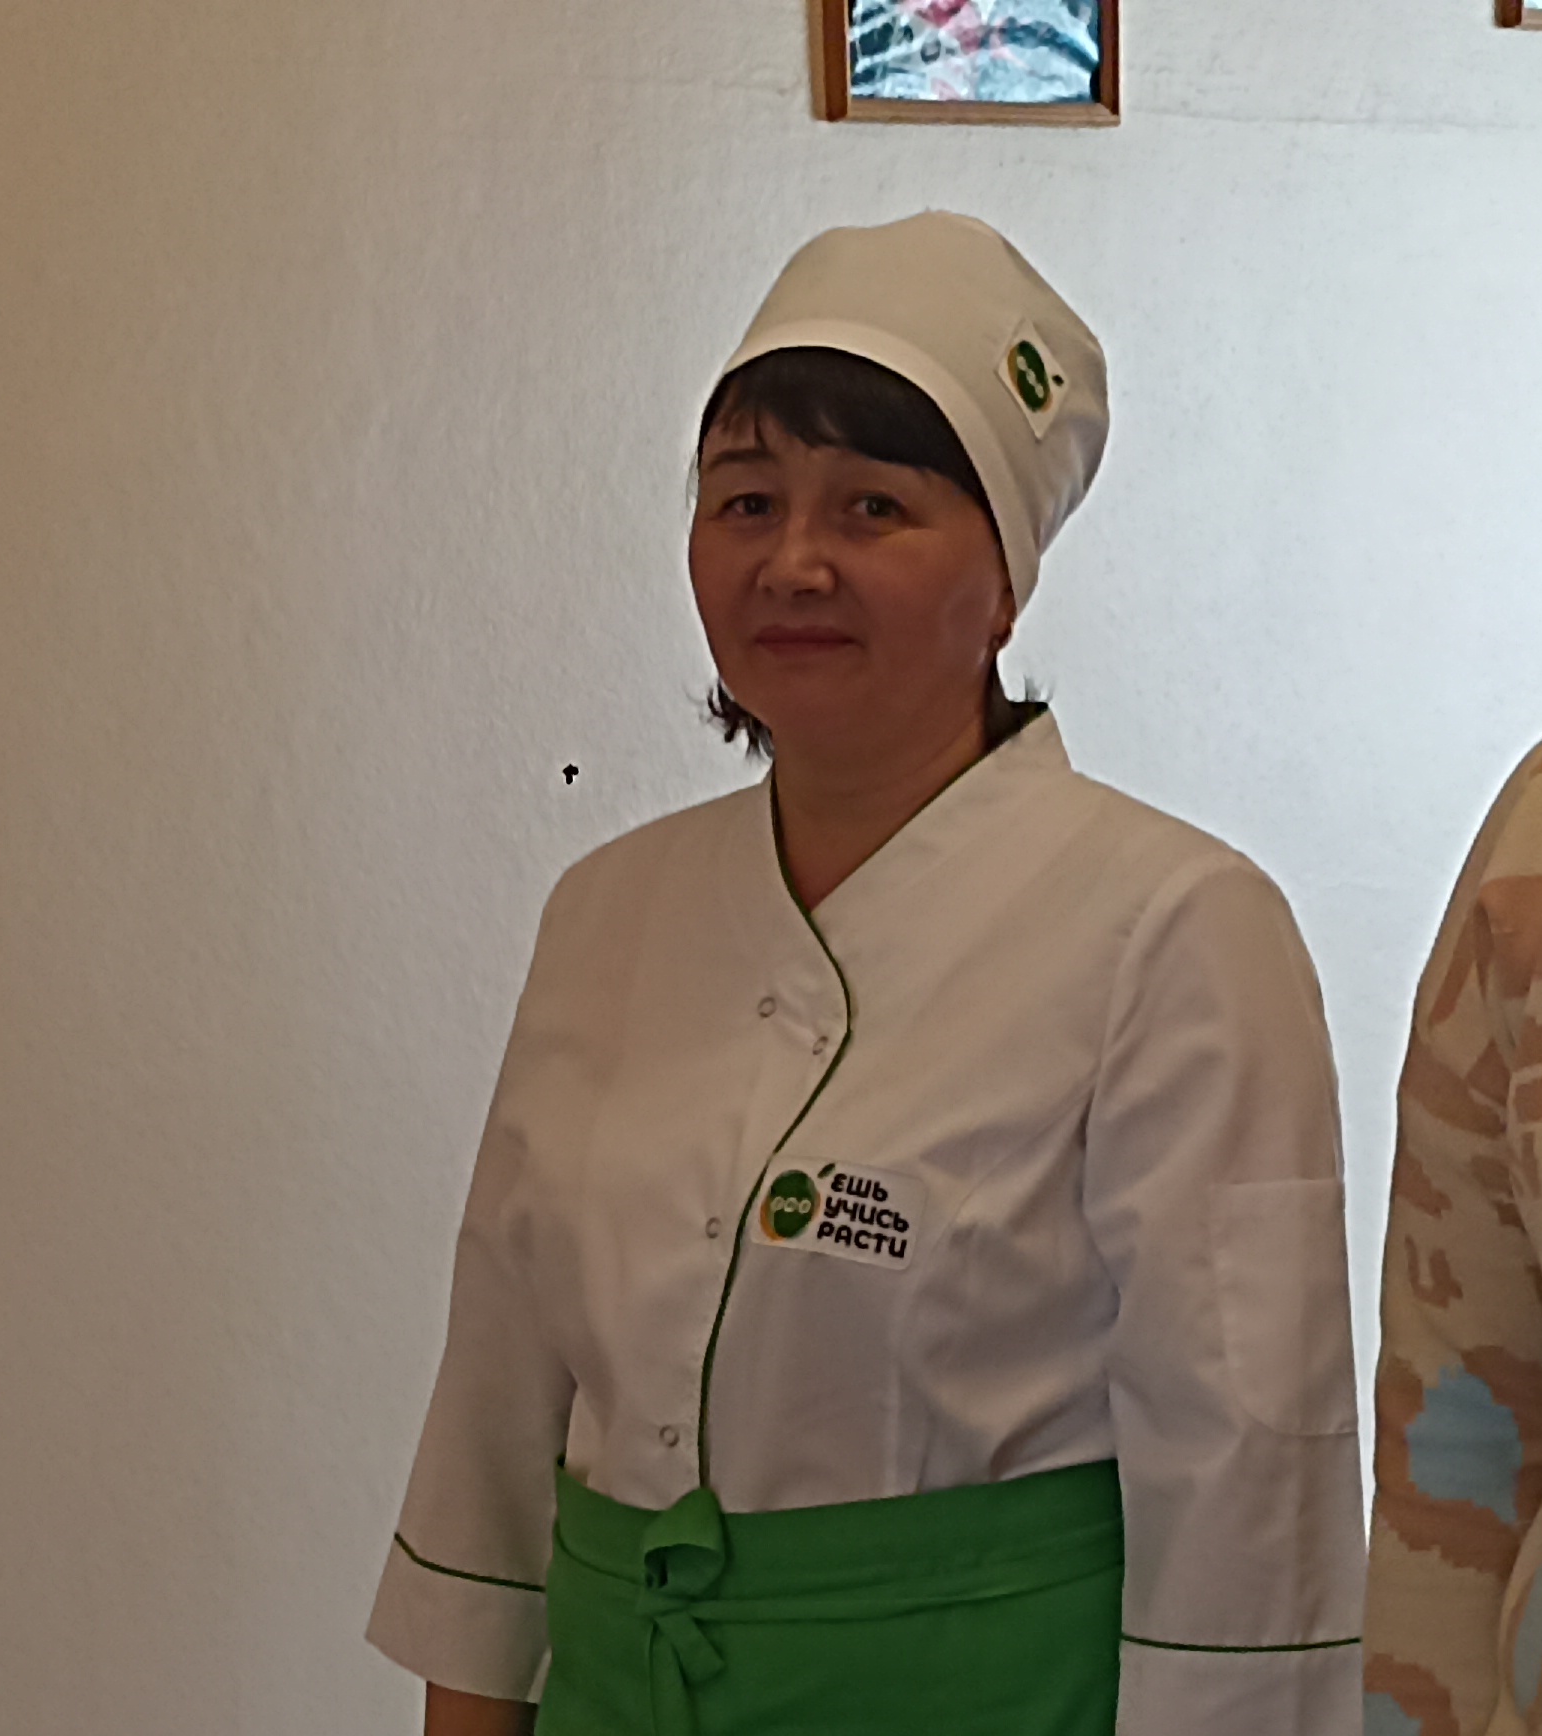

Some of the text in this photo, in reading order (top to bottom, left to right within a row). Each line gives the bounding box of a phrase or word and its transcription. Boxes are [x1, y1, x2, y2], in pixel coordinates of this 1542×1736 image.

[831, 1173, 888, 1202] ЕШЬ
[824, 1196, 909, 1232] УЧИСЬ
[817, 1222, 907, 1258] РАСТИ
